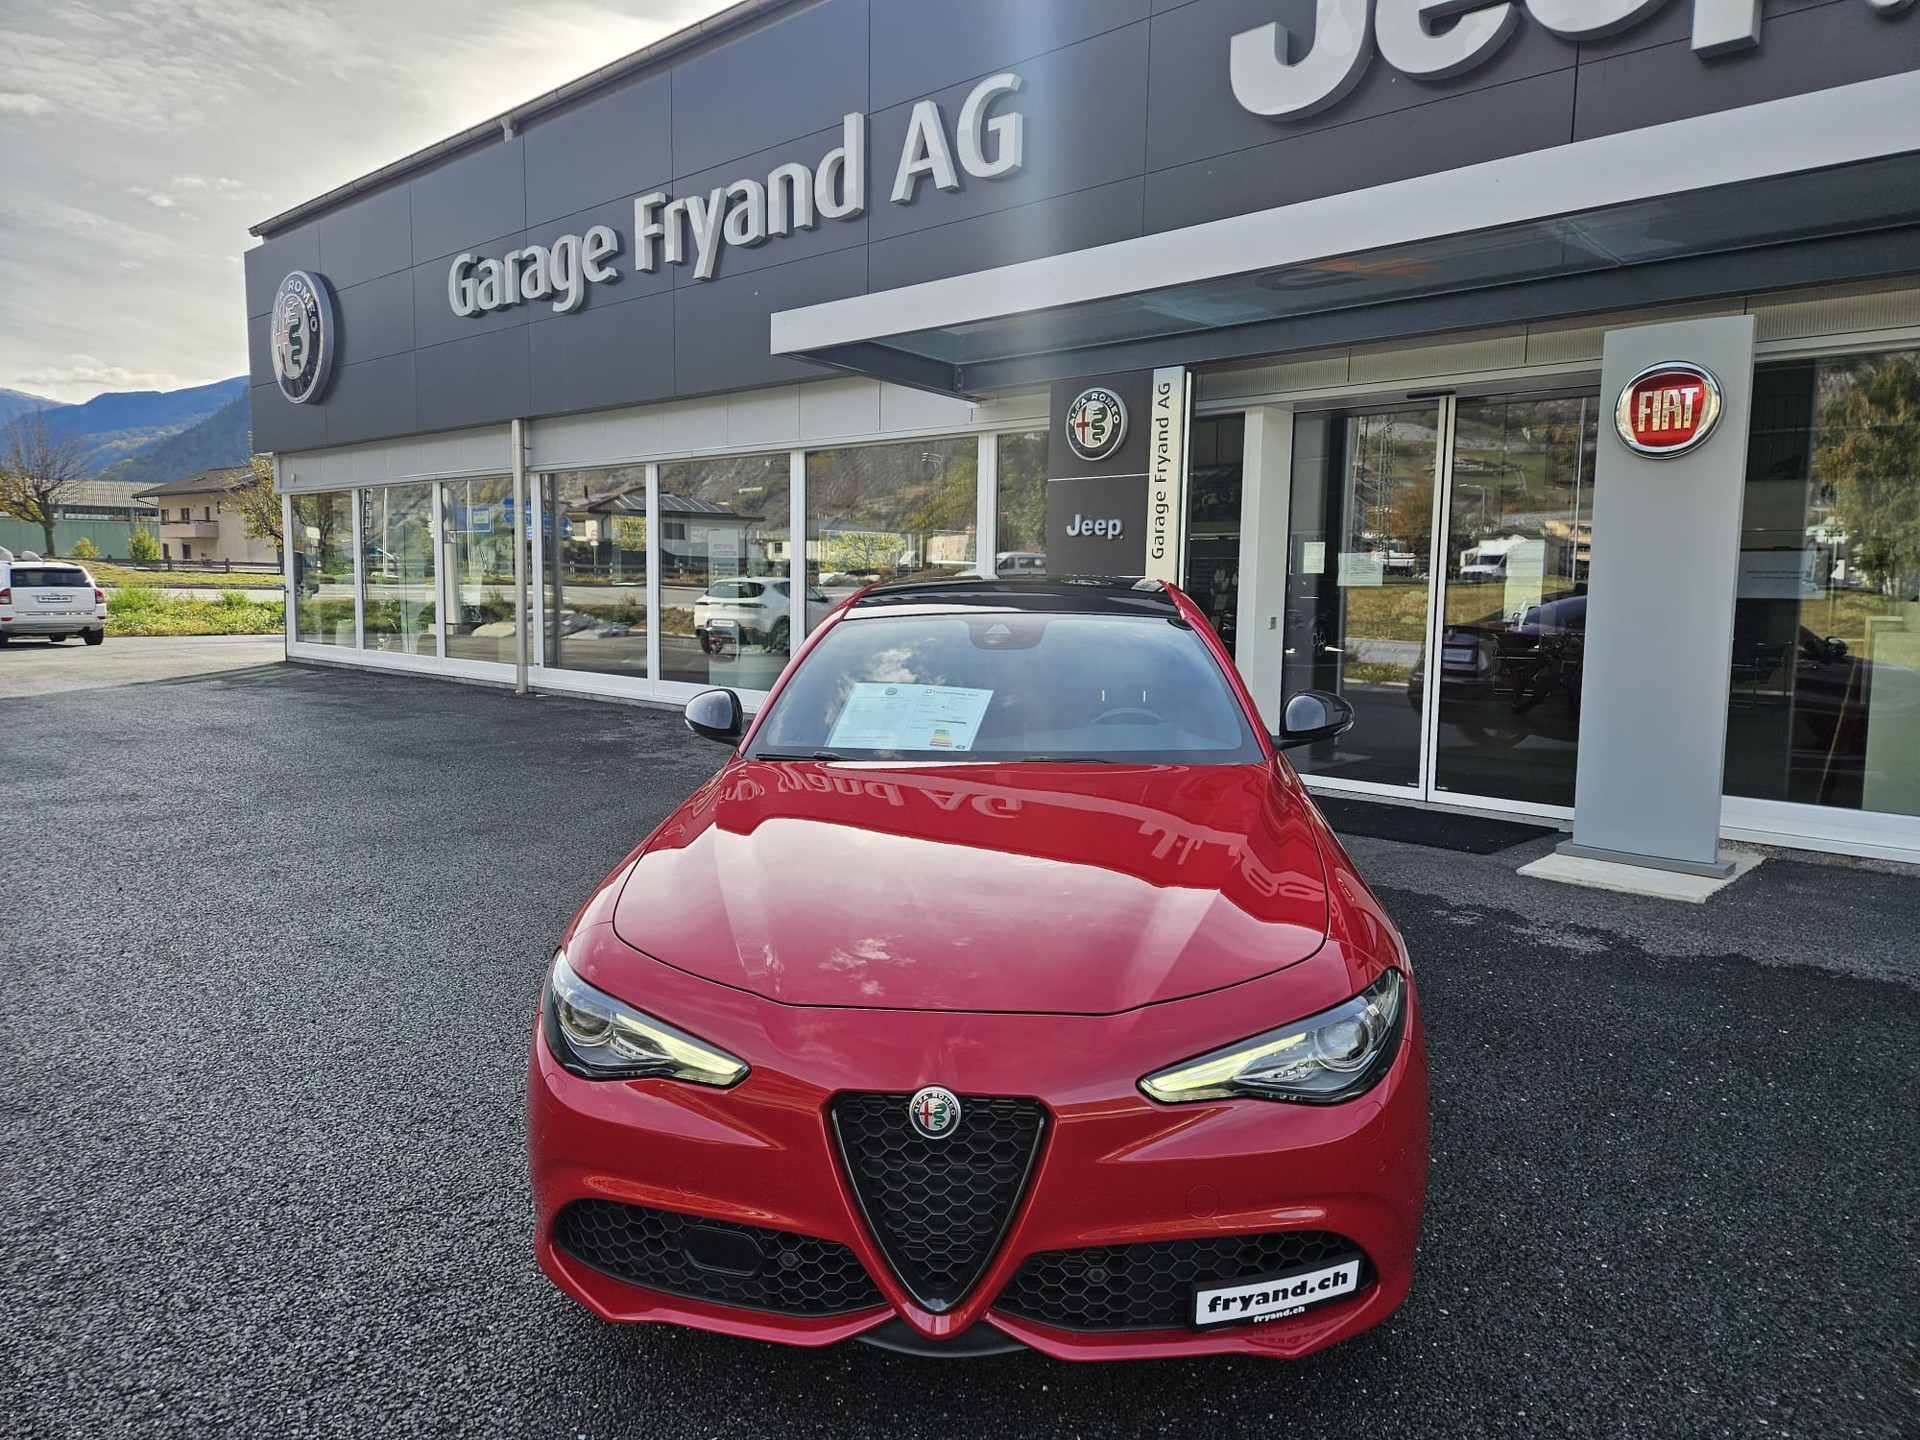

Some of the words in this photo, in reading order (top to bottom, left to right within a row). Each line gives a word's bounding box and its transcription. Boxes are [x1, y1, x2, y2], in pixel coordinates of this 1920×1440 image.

[1230, 0, 1757, 121] Je
[448, 225, 618, 316] Garage
[634, 111, 864, 280] Fryand
[889, 72, 1023, 203] AG
[287, 279, 318, 332] ROMEO
[1069, 397, 1088, 427] ALFA
[1091, 392, 1120, 424] ROMEO
[1157, 382, 1171, 409] AG
[1637, 386, 1700, 433] FIAT
[1154, 416, 1171, 483] Fryand
[1066, 514, 1123, 540] Jeep
[1151, 490, 1169, 560] Garage
[914, 1094, 929, 1114] ALFA
[931, 1092, 956, 1116] ROMEO
[1207, 1271, 1349, 1313] fryand.ch
[1253, 1305, 1306, 1323] fryand.ch
